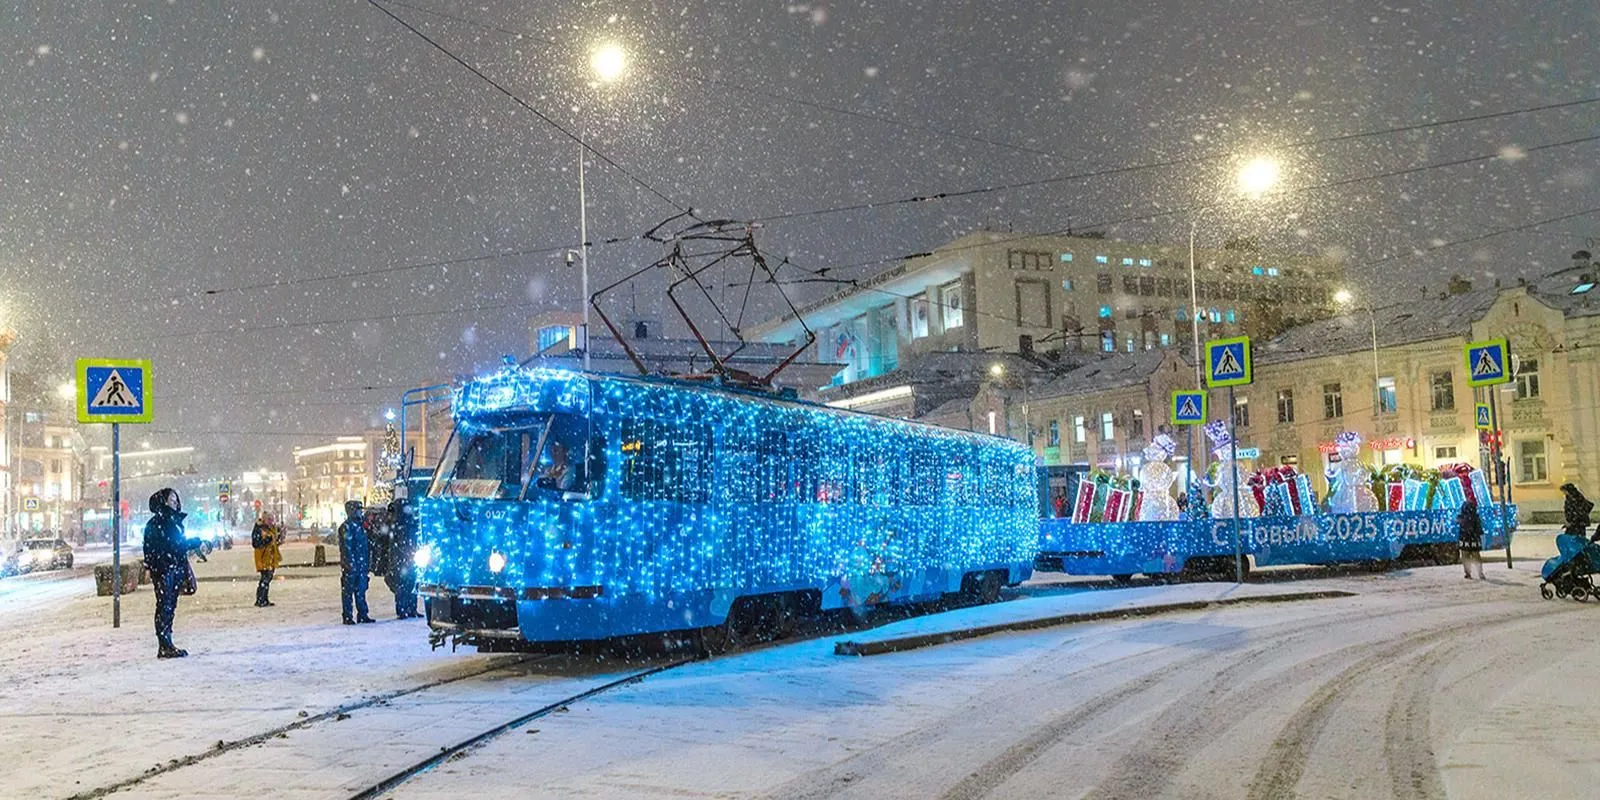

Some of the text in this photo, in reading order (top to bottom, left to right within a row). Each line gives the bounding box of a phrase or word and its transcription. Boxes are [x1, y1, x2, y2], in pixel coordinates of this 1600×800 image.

[1211, 514, 1446, 546] С Новым 2025 годом
